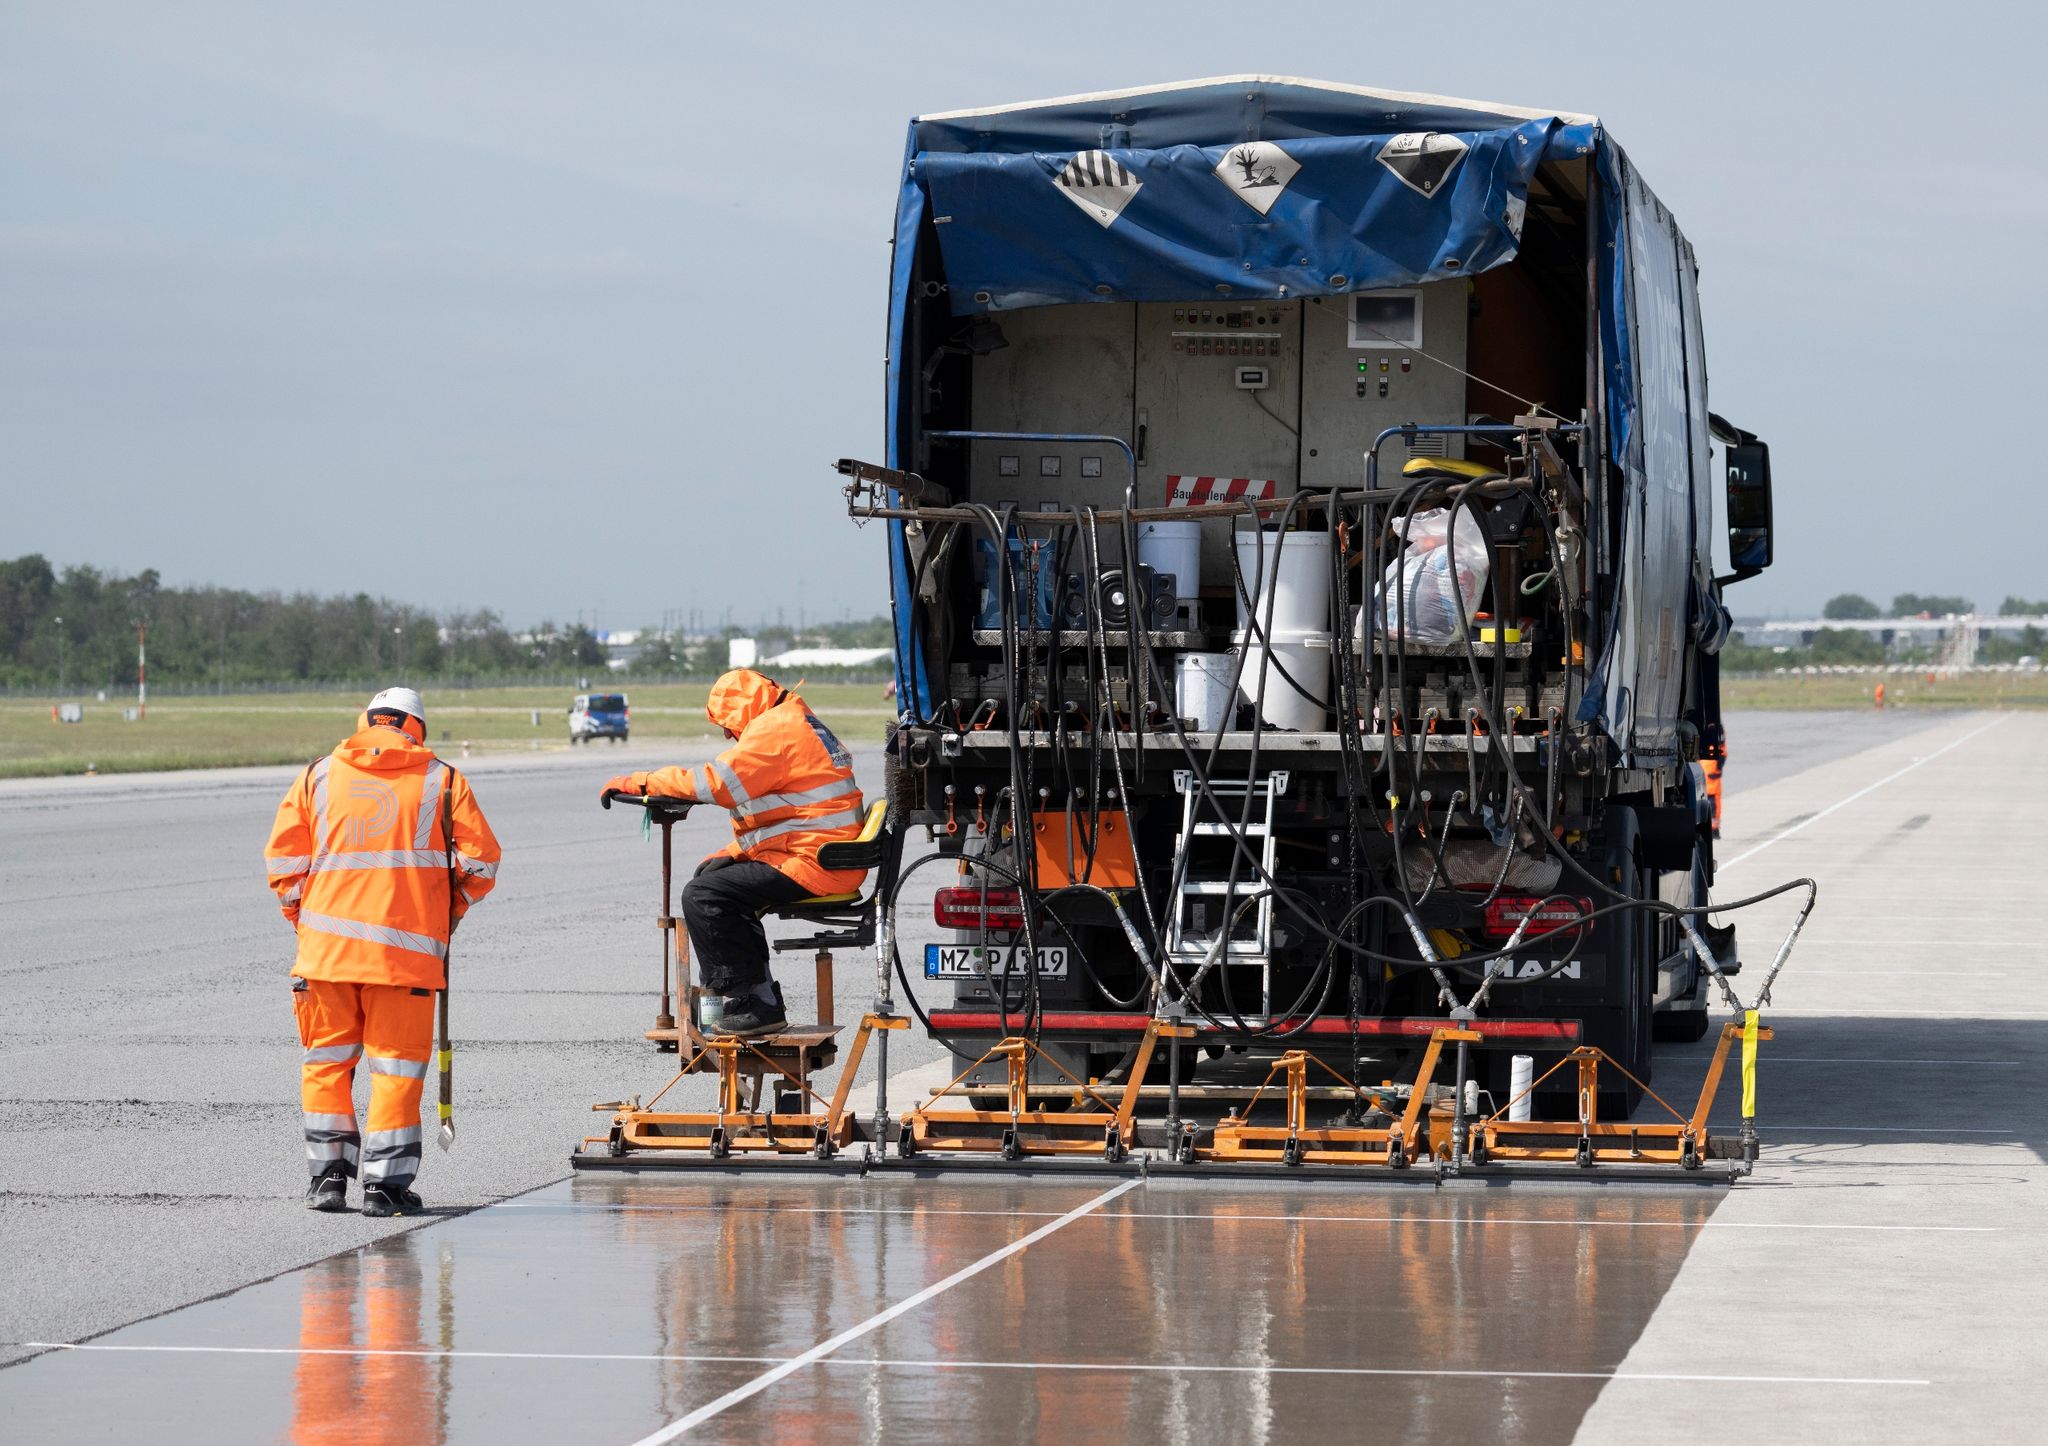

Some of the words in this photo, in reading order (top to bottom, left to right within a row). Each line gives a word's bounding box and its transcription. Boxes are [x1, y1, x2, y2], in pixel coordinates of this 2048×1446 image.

[1424, 181, 1431, 189] 8
[941, 949, 970, 971] MZ
[988, 949, 1001, 971] P
[1008, 950, 1064, 972] 119
[1484, 959, 1581, 979] MAN
